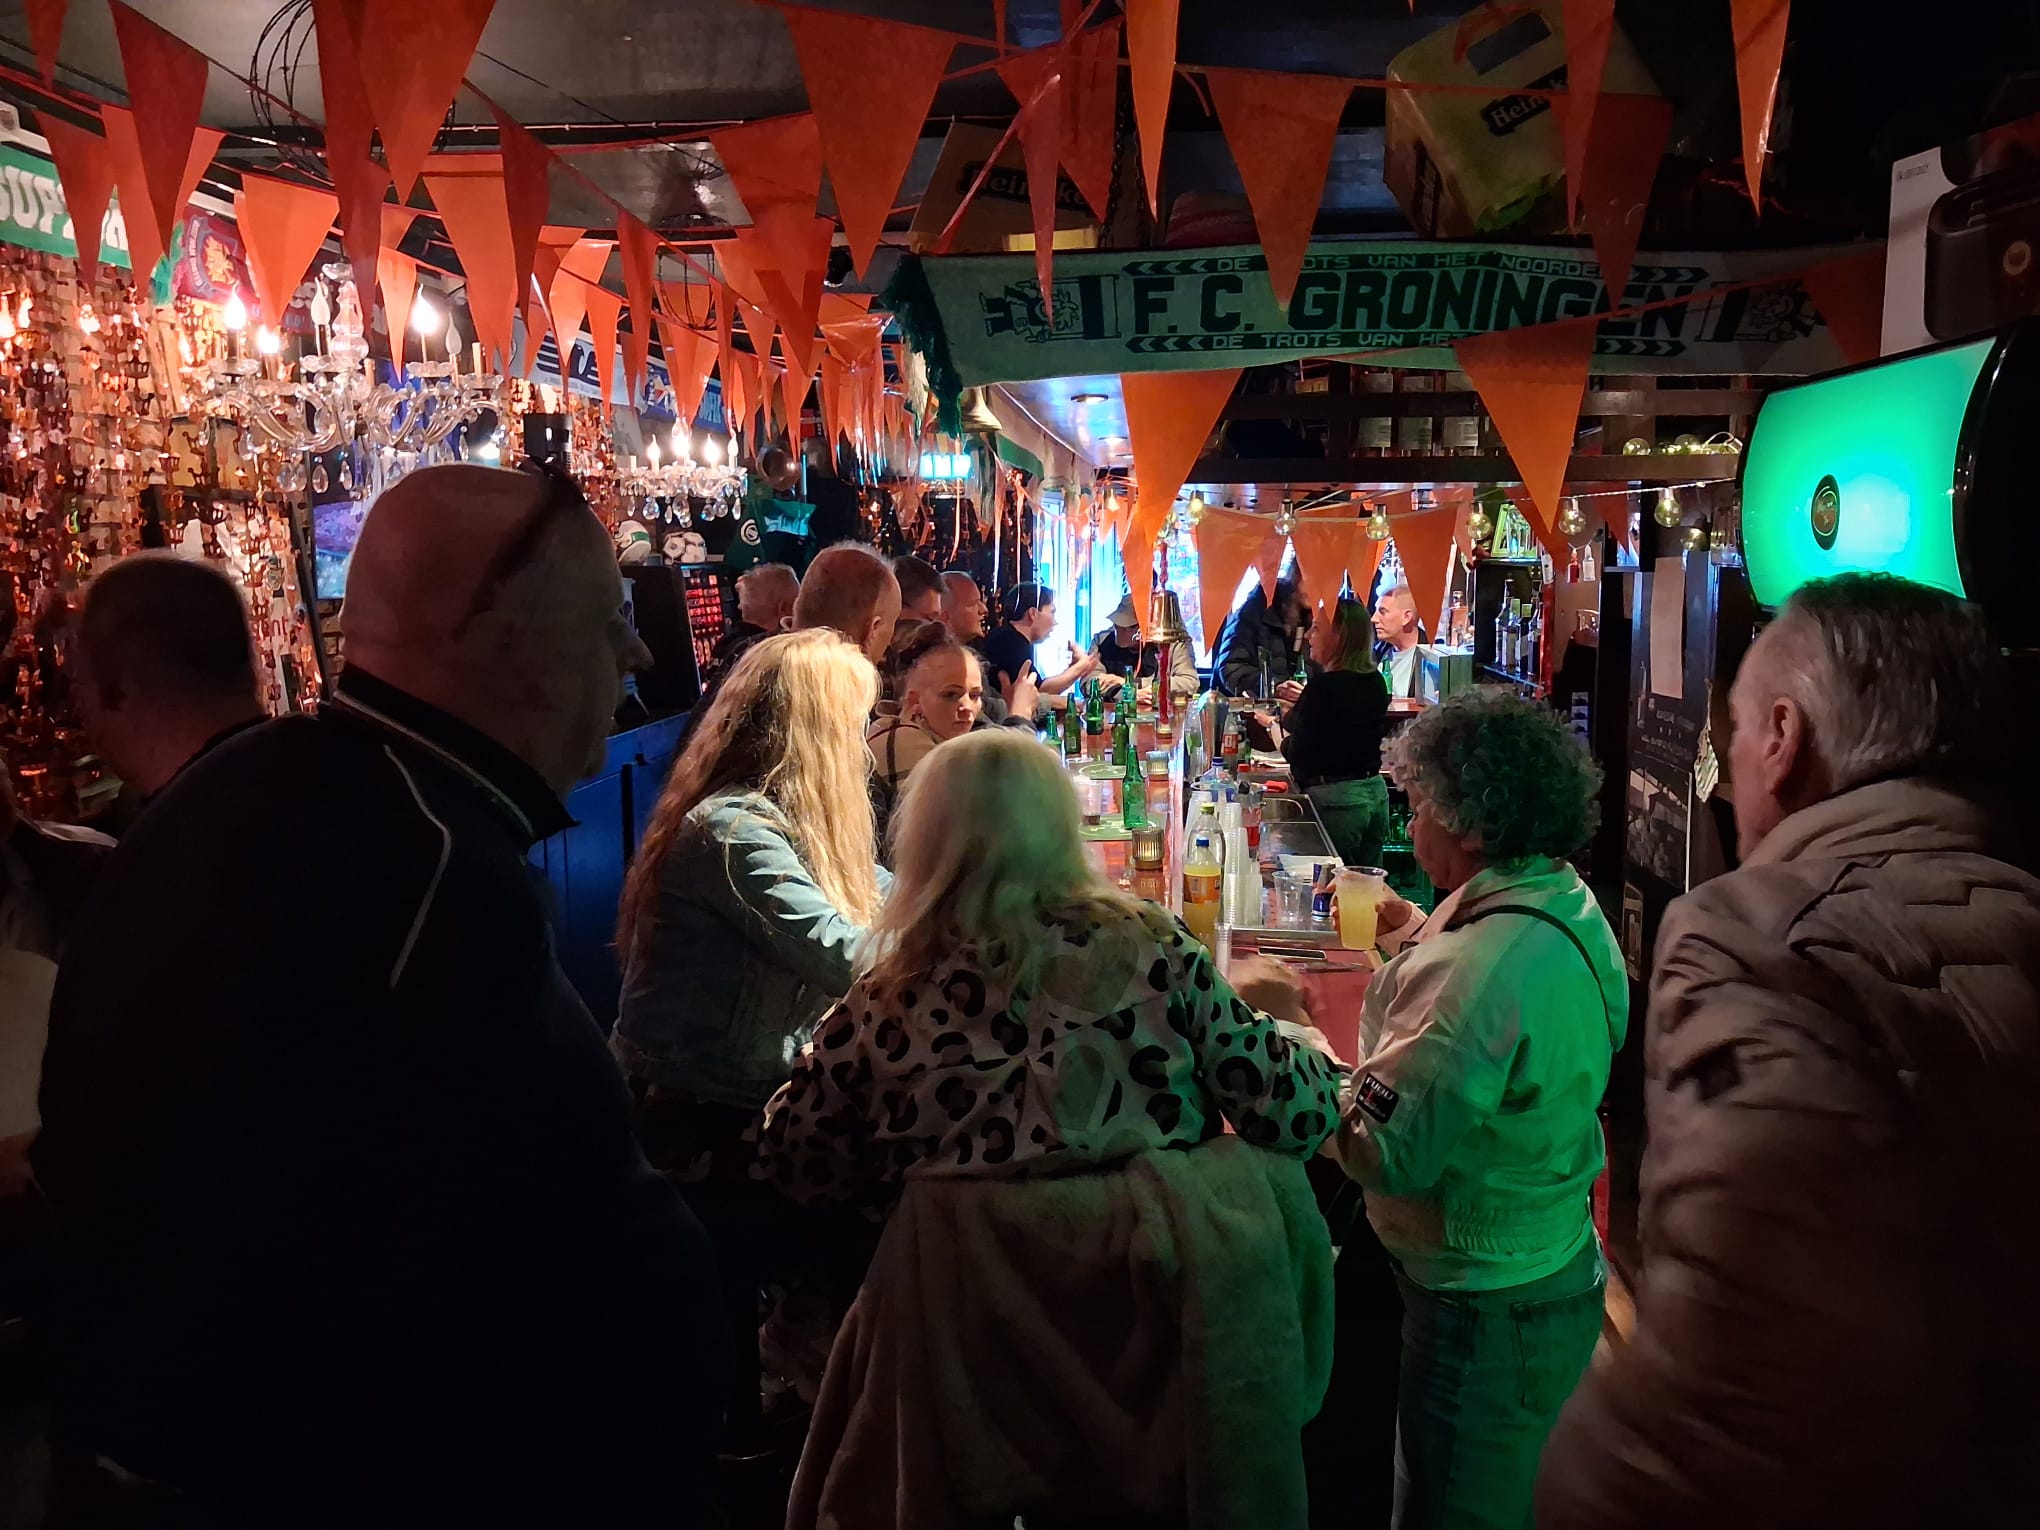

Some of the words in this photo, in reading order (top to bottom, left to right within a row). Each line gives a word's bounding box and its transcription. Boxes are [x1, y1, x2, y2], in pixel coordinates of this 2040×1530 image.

[1217, 257, 1250, 272] DE
[1302, 256, 1350, 270] OTS
[1368, 254, 1417, 268] VAN
[1434, 252, 1481, 267] HET
[1499, 256, 1602, 278] NOORDE
[1133, 276, 1178, 335] F.
[1200, 273, 1255, 333] C.
[1212, 335, 1245, 349] DE
[1260, 333, 1342, 348] TROTS
[1358, 333, 1403, 347] VAN
